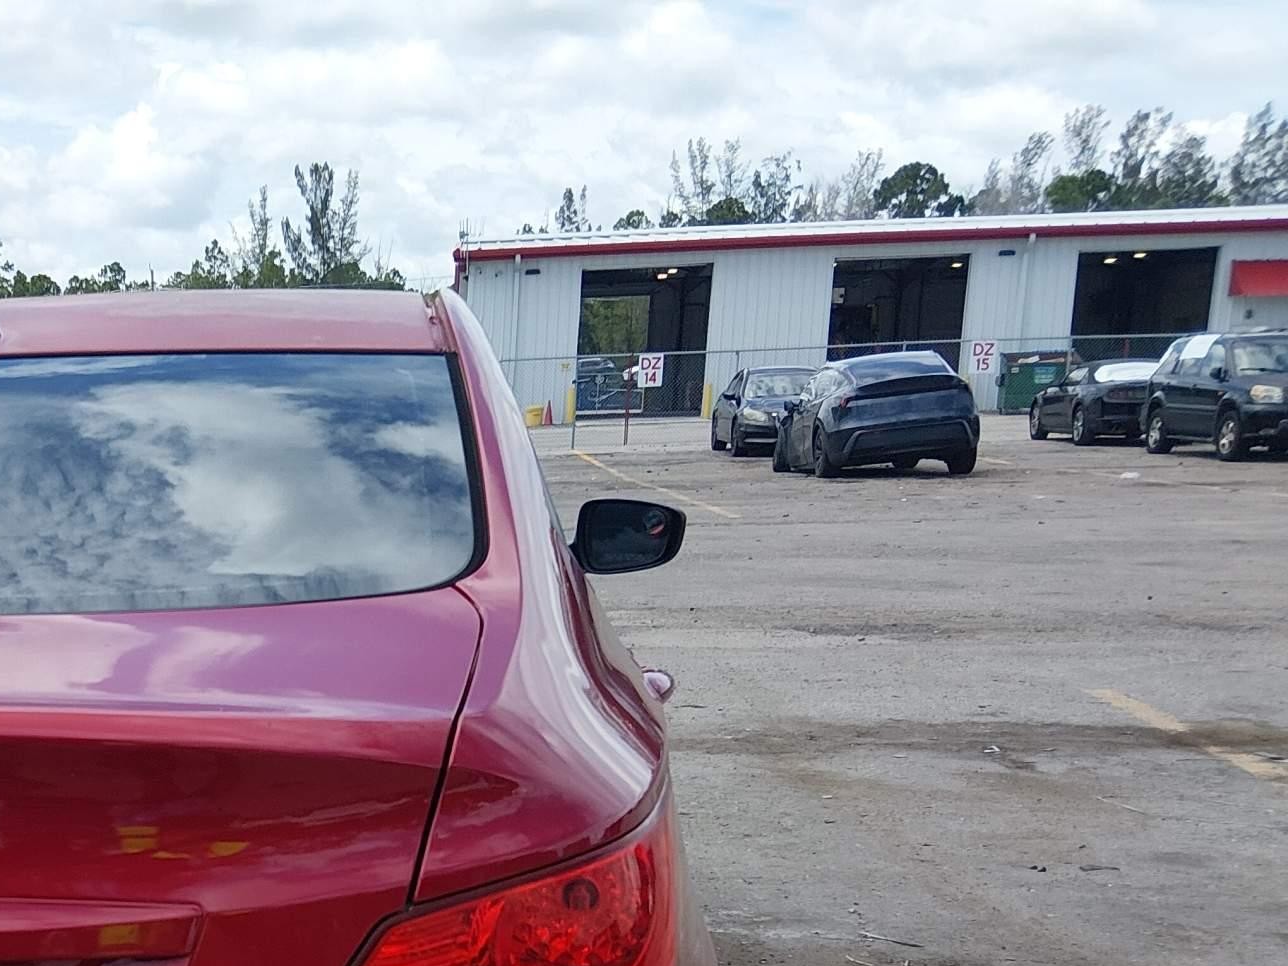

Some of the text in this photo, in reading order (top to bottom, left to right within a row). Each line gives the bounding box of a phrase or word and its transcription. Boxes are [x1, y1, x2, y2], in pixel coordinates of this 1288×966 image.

[973, 343, 995, 356] DZ
[641, 356, 662, 370] DZ
[976, 358, 990, 371] 15
[644, 371, 657, 385] 14
